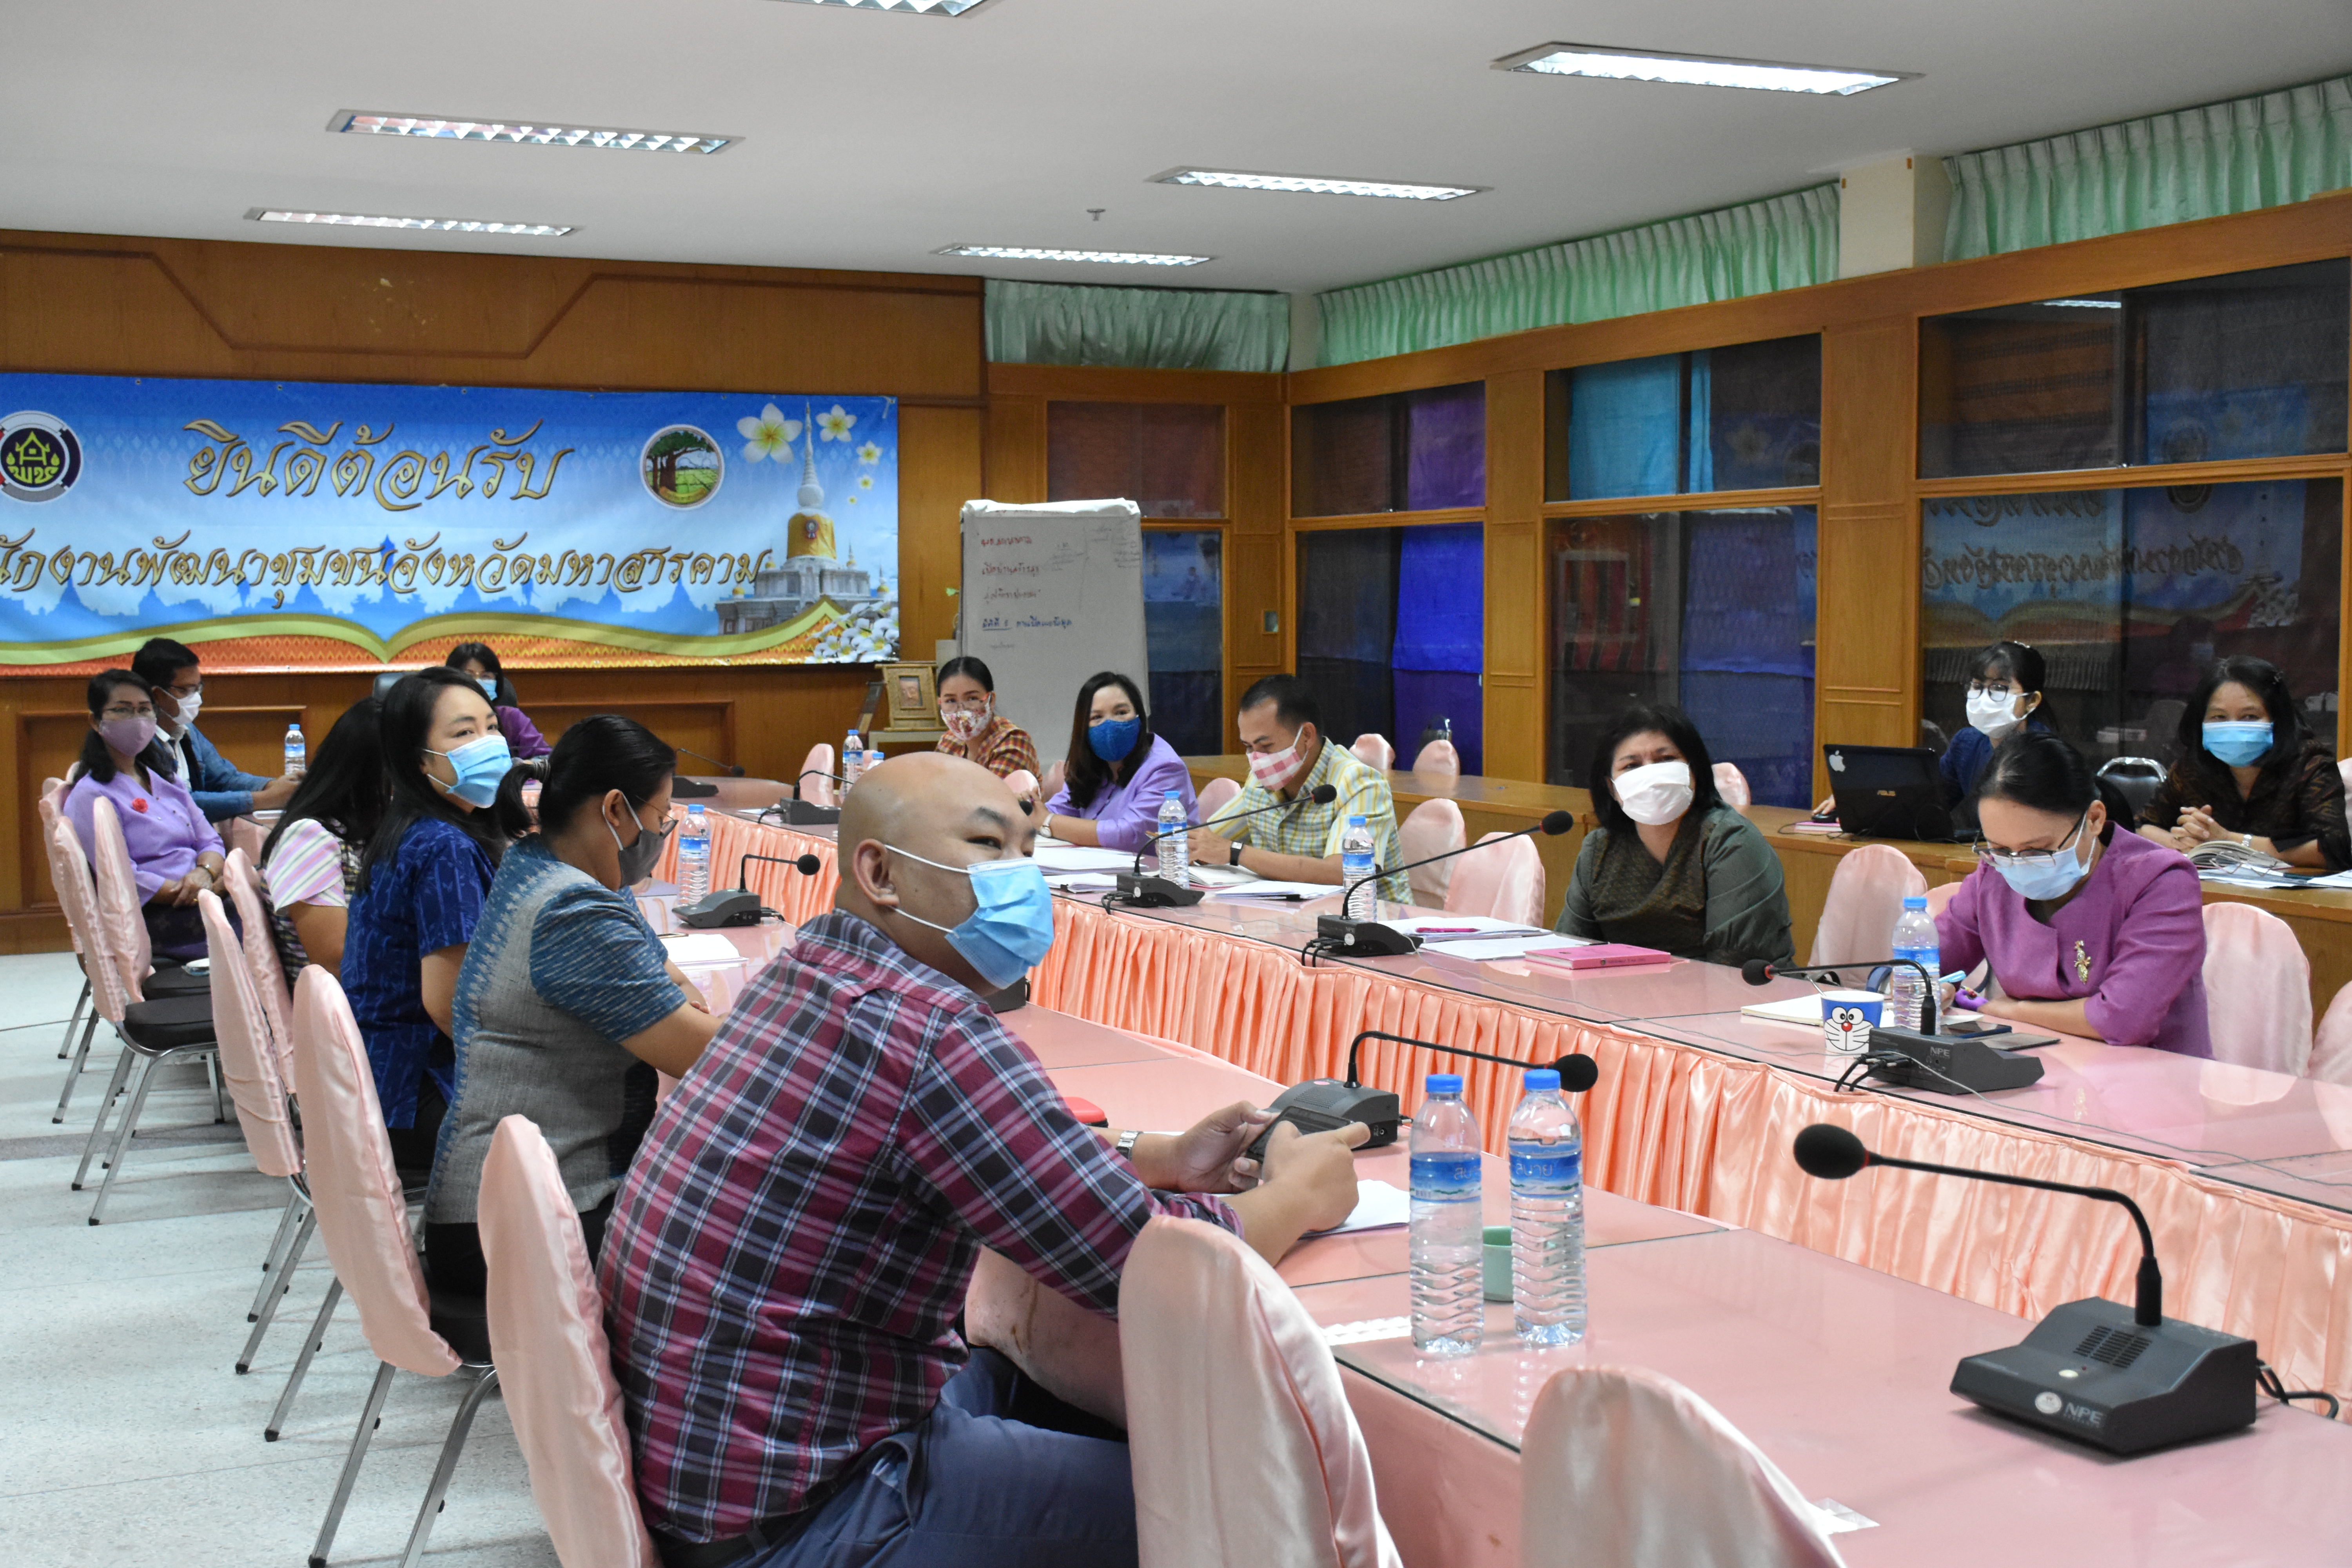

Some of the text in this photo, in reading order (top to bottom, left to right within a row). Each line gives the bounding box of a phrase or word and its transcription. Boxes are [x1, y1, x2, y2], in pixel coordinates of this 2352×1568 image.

[183, 418, 575, 511] ยินดีต้อนรับ
[1930, 1046, 1950, 1056] NPE
[2064, 1401, 2104, 1425] NPE
